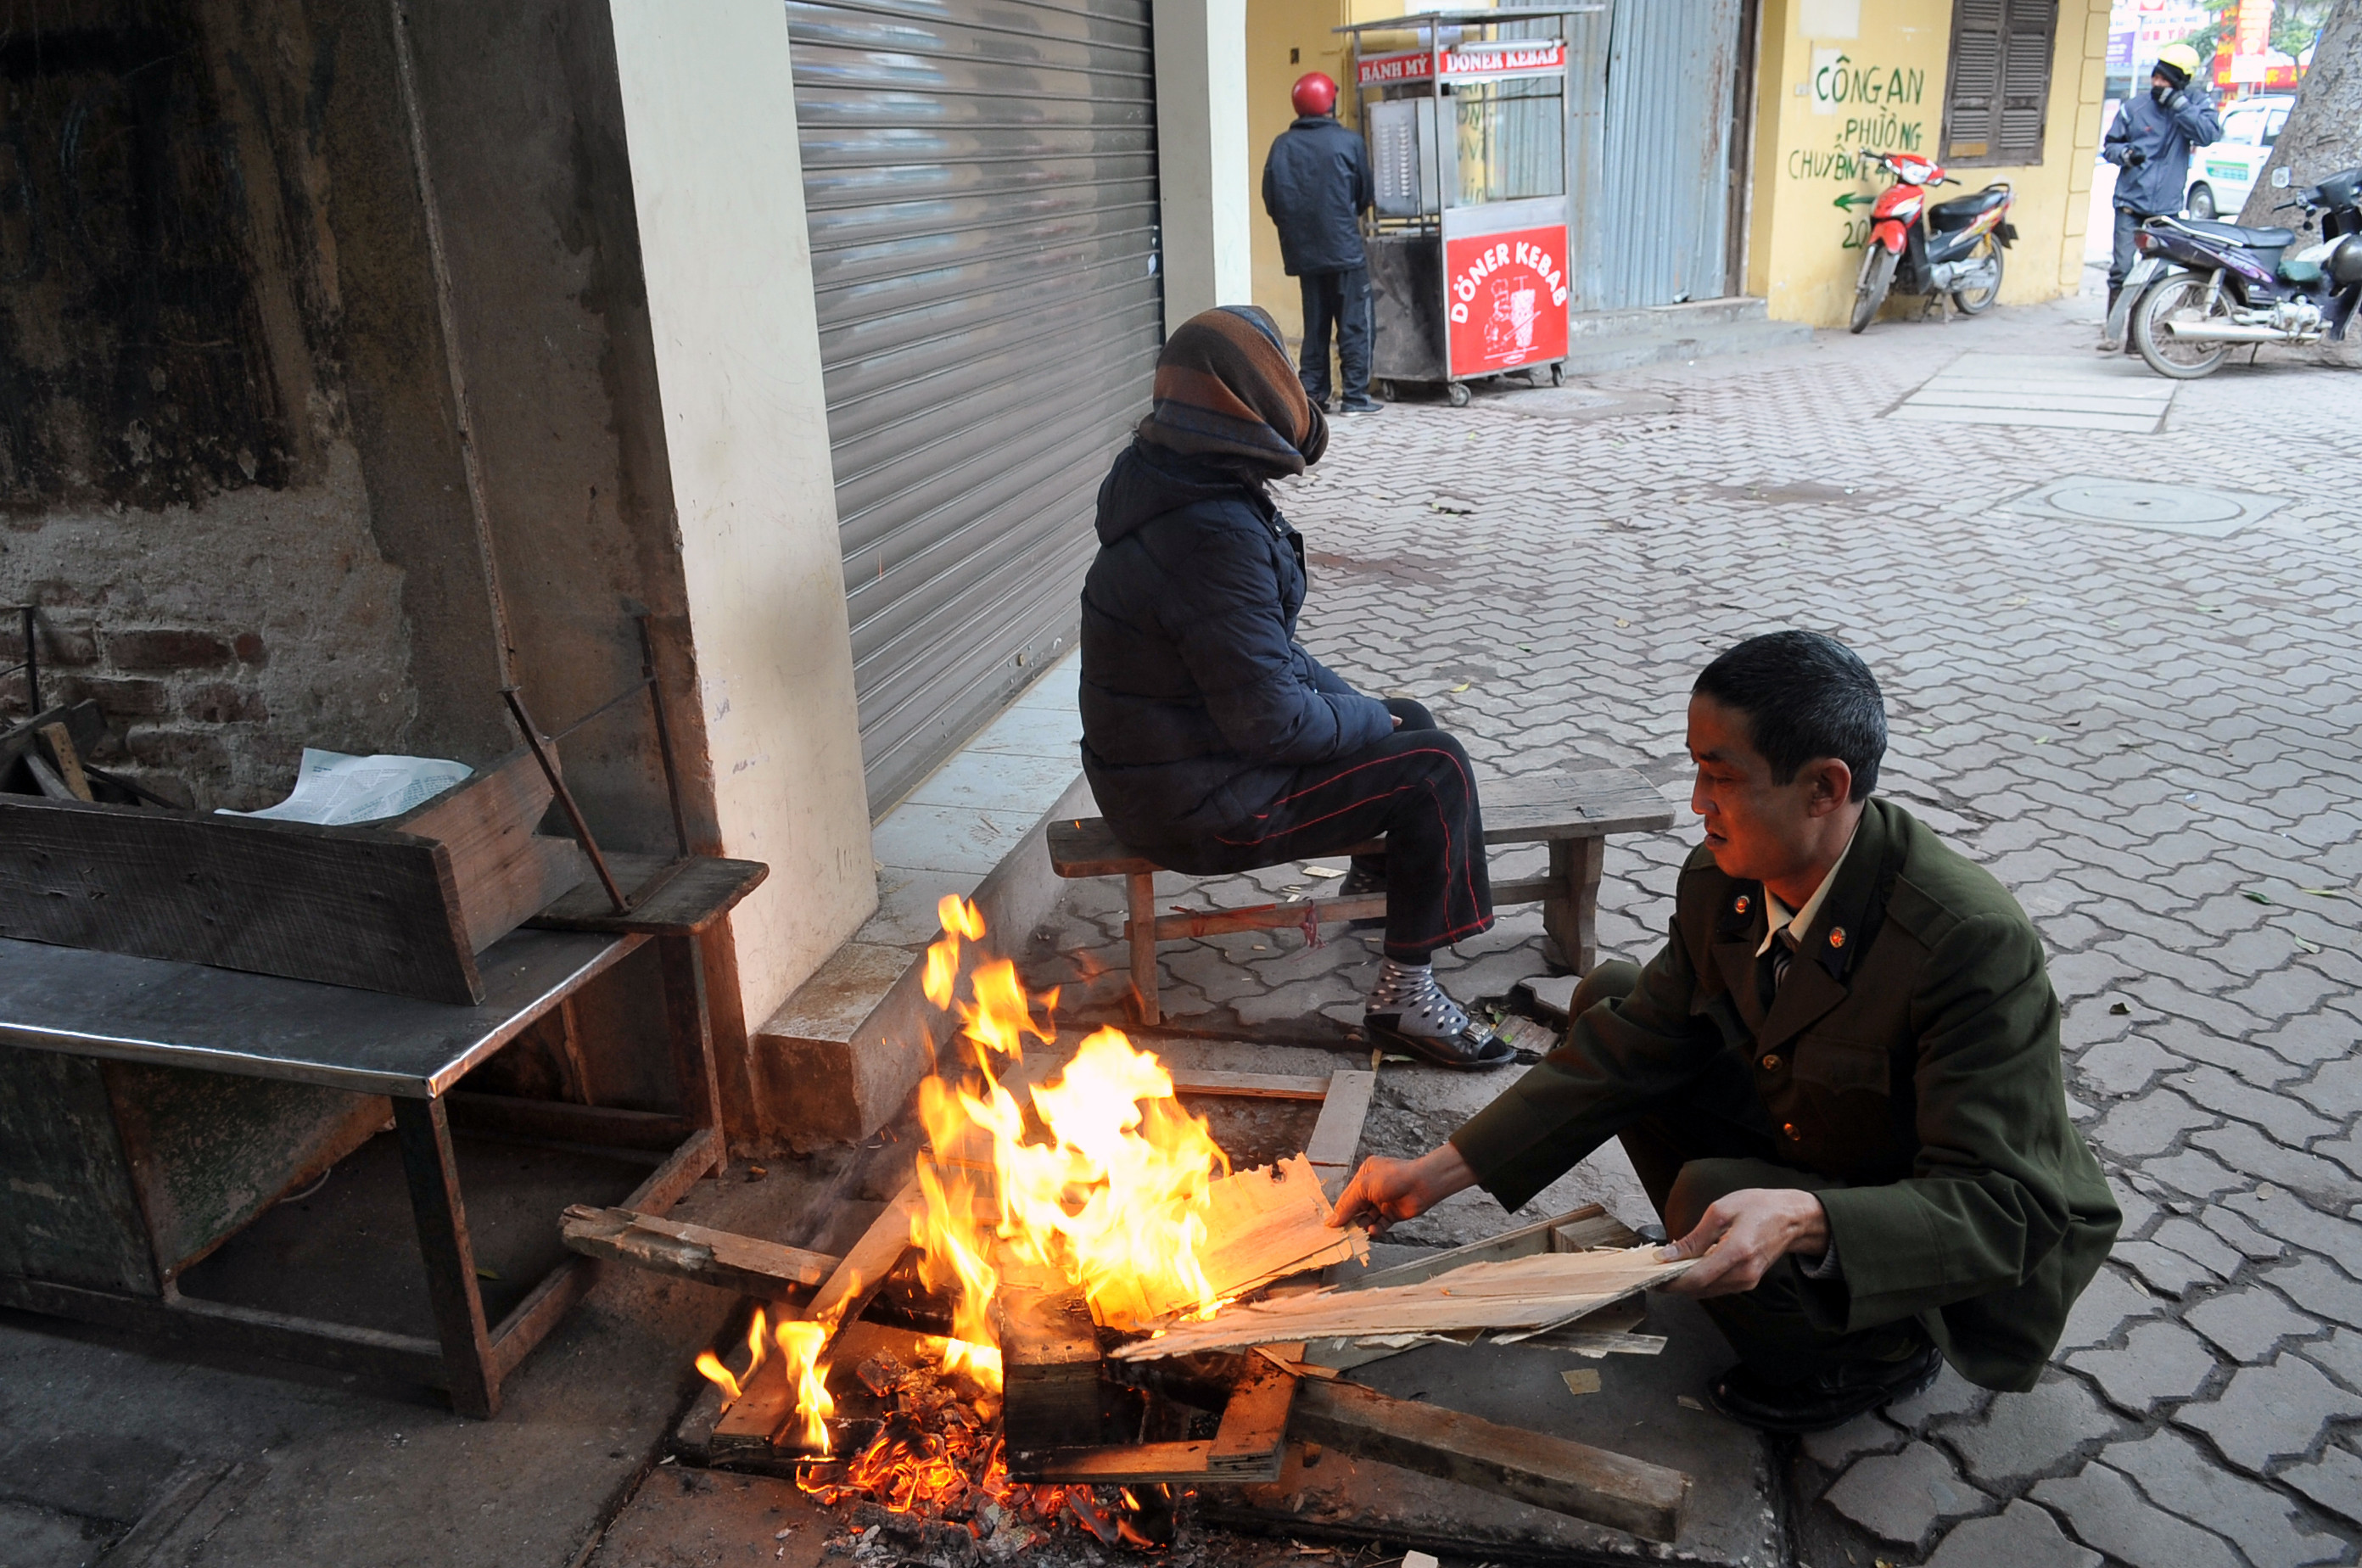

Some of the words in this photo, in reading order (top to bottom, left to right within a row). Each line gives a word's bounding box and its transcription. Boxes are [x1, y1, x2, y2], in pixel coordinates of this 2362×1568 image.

[1362, 60, 1402, 81] BÁNH
[1506, 48, 1559, 68] KEBAB
[1816, 55, 1883, 104] CÔNG
[1887, 67, 1924, 104] AN
[1451, 243, 1510, 324] DÖNER
[1515, 241, 1568, 307] KEBAB
